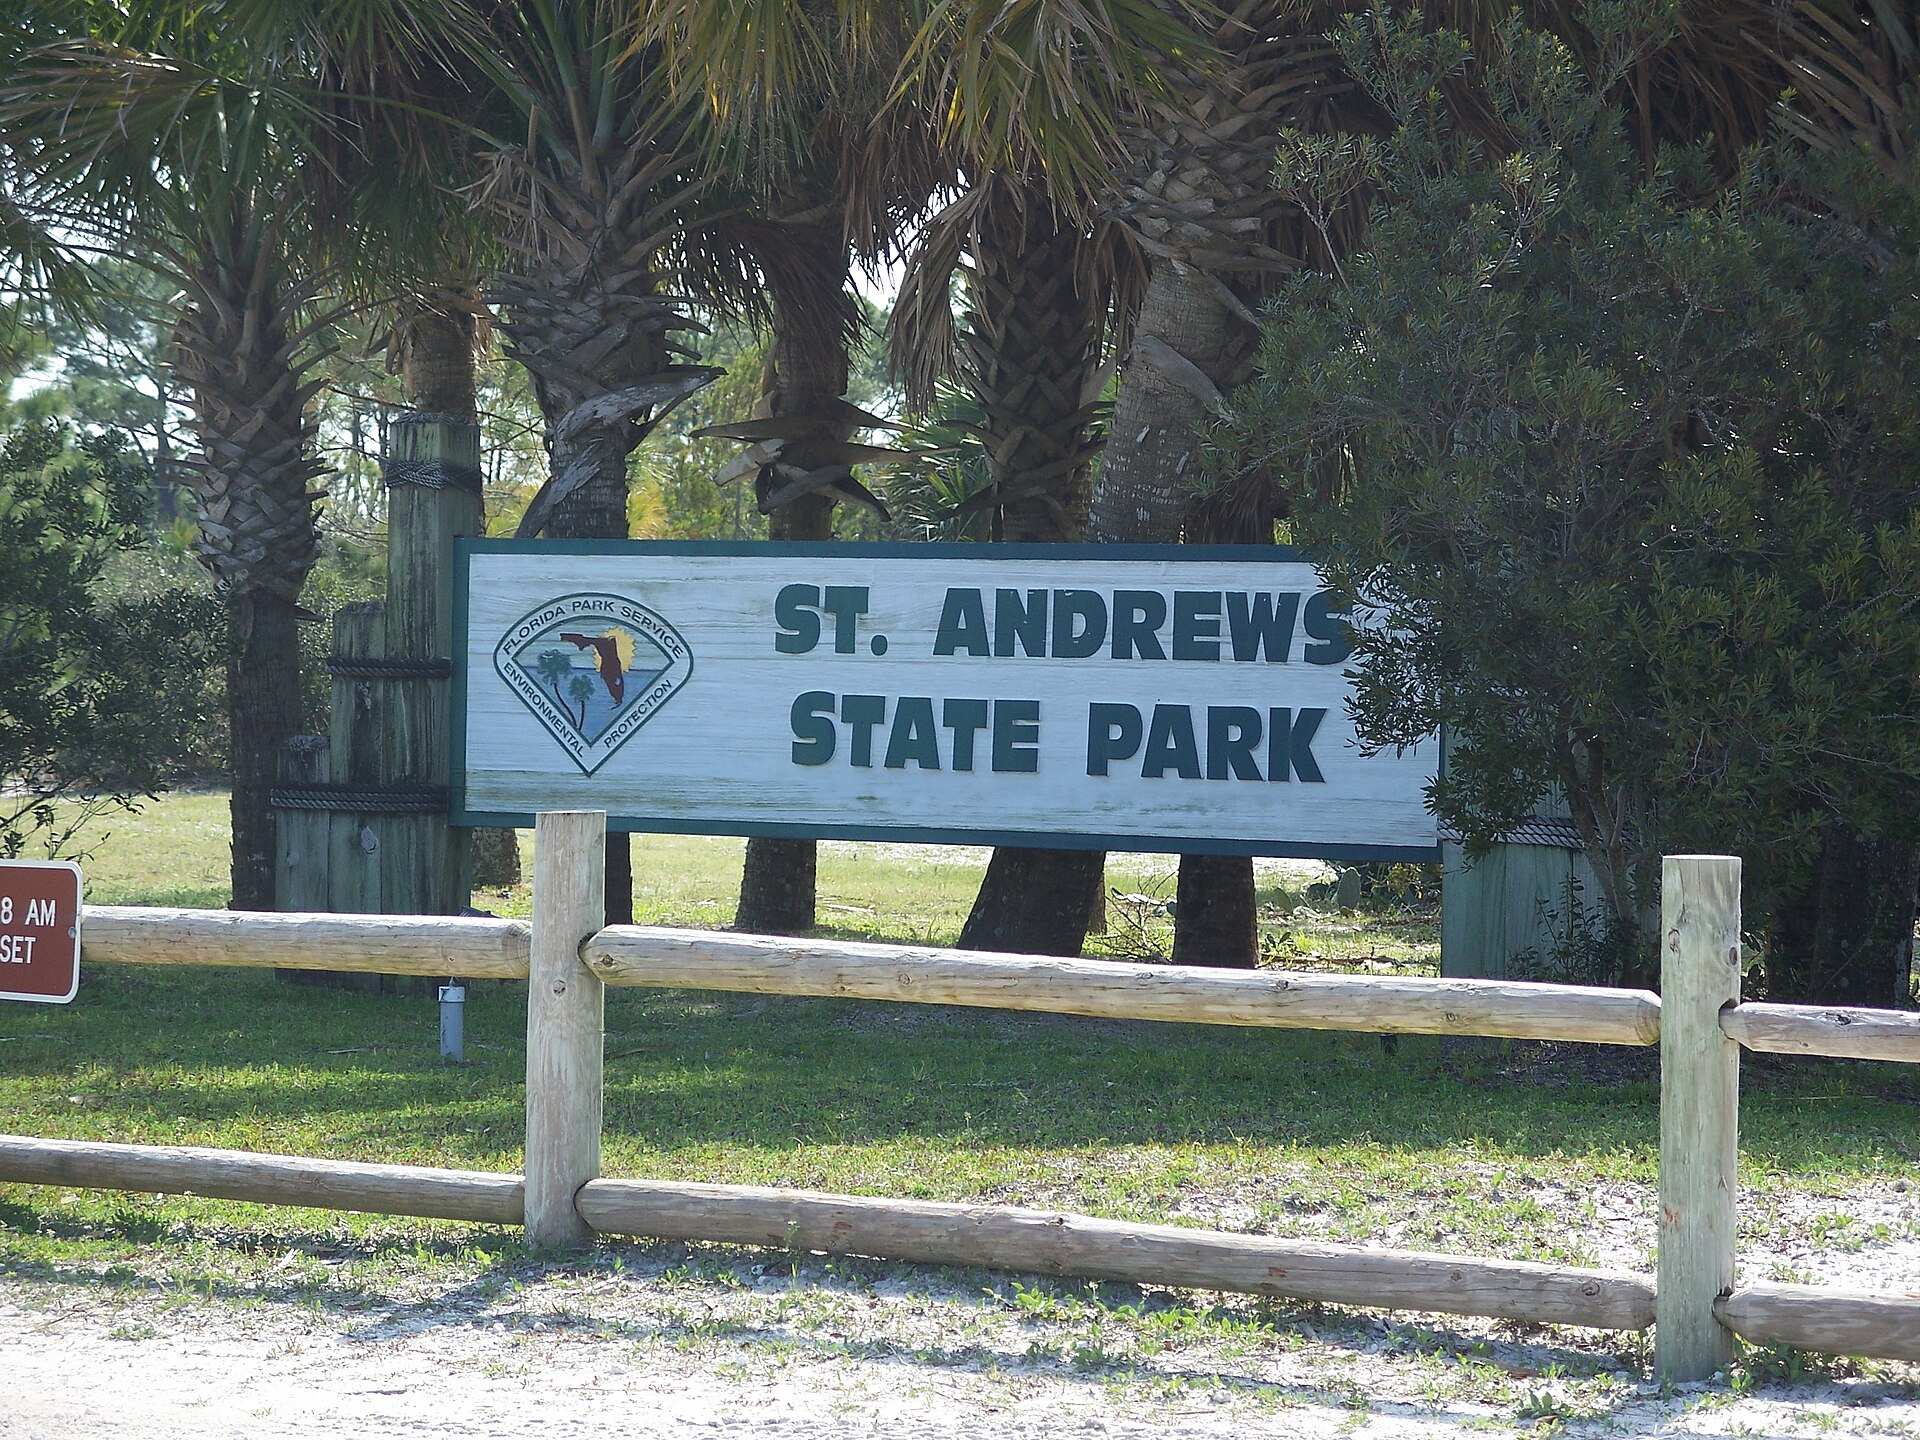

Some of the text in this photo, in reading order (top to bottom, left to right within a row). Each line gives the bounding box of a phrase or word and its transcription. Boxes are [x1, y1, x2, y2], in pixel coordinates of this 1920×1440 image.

[503, 600, 684, 659] FLORIDA PARK SERVICE
[775, 584, 1352, 665] ST. ANDREWS
[504, 662, 584, 758] ENVIRONMENTAL
[604, 679, 673, 749] PROTECTION
[790, 690, 1328, 783] STATE PARK
[2, 897, 56, 926] 8 AM
[0, 935, 36, 964] SET
